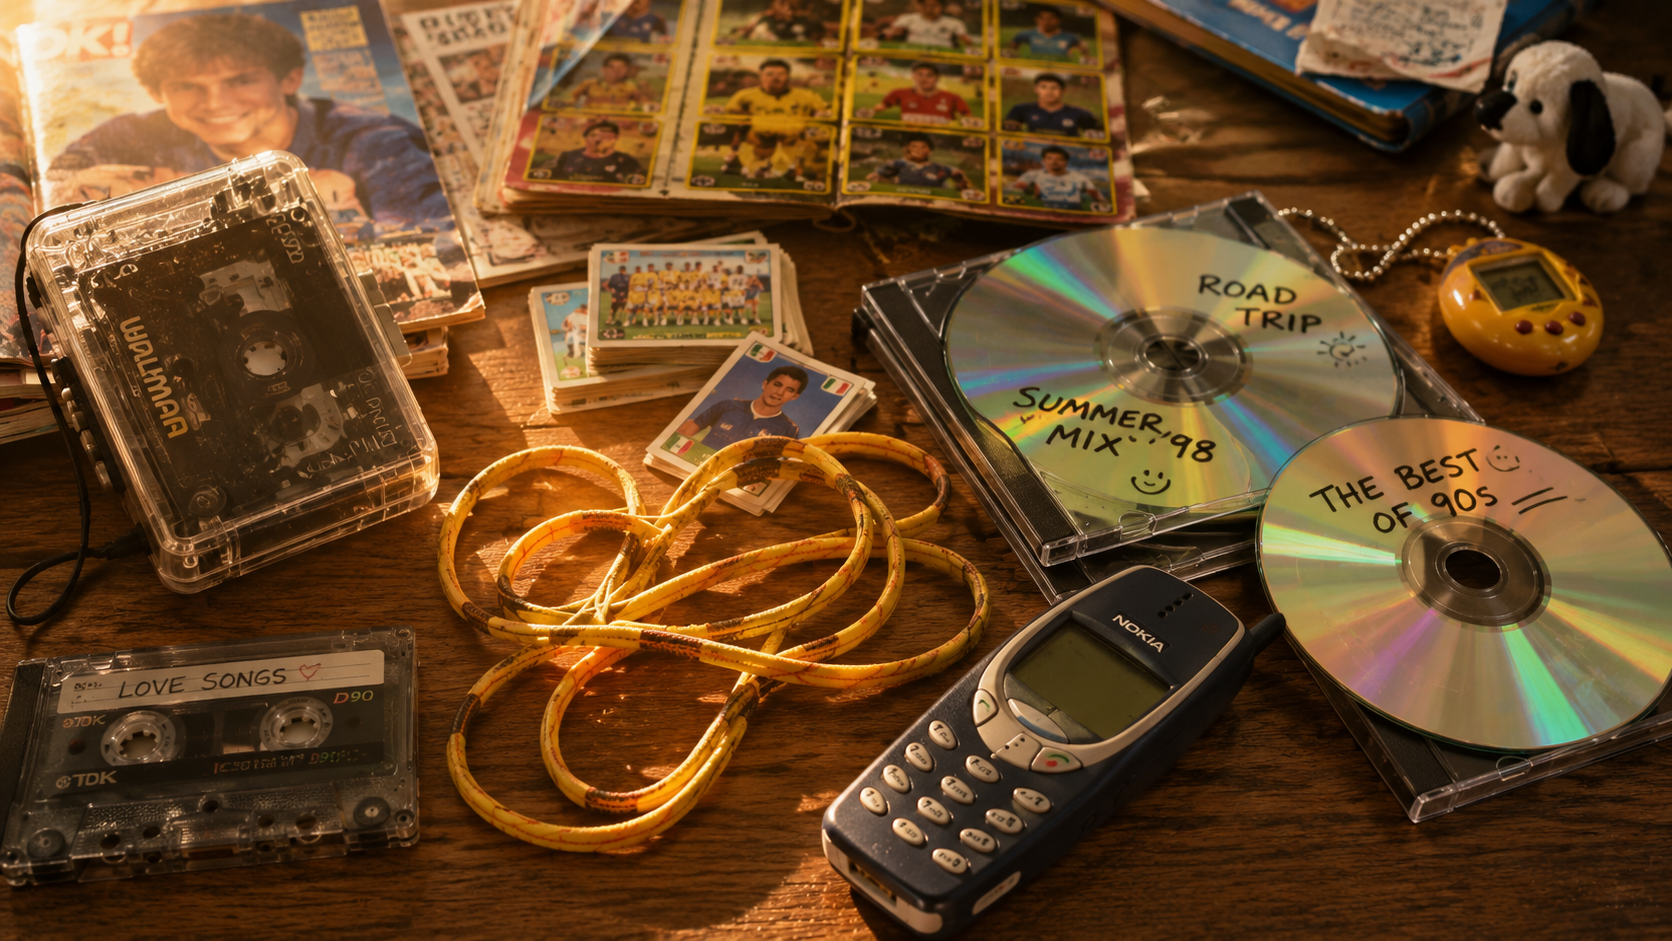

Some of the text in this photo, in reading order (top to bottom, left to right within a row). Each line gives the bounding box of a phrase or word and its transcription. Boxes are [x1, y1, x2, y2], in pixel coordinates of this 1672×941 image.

[27, 21, 131, 61] OK!
[1198, 273, 1297, 305] ROAD
[1235, 306, 1322, 334] TRIP
[1012, 386, 1163, 433] SUMMER
[1045, 424, 1123, 457] MIX
[1309, 447, 1480, 513] THE BEST
[1372, 501, 1413, 534] OF
[1112, 614, 1165, 654] NOKIA
[118, 675, 187, 699] LOVE
[201, 667, 288, 691] SONGS
[333, 690, 375, 704] D90
[71, 770, 117, 787] TDK
